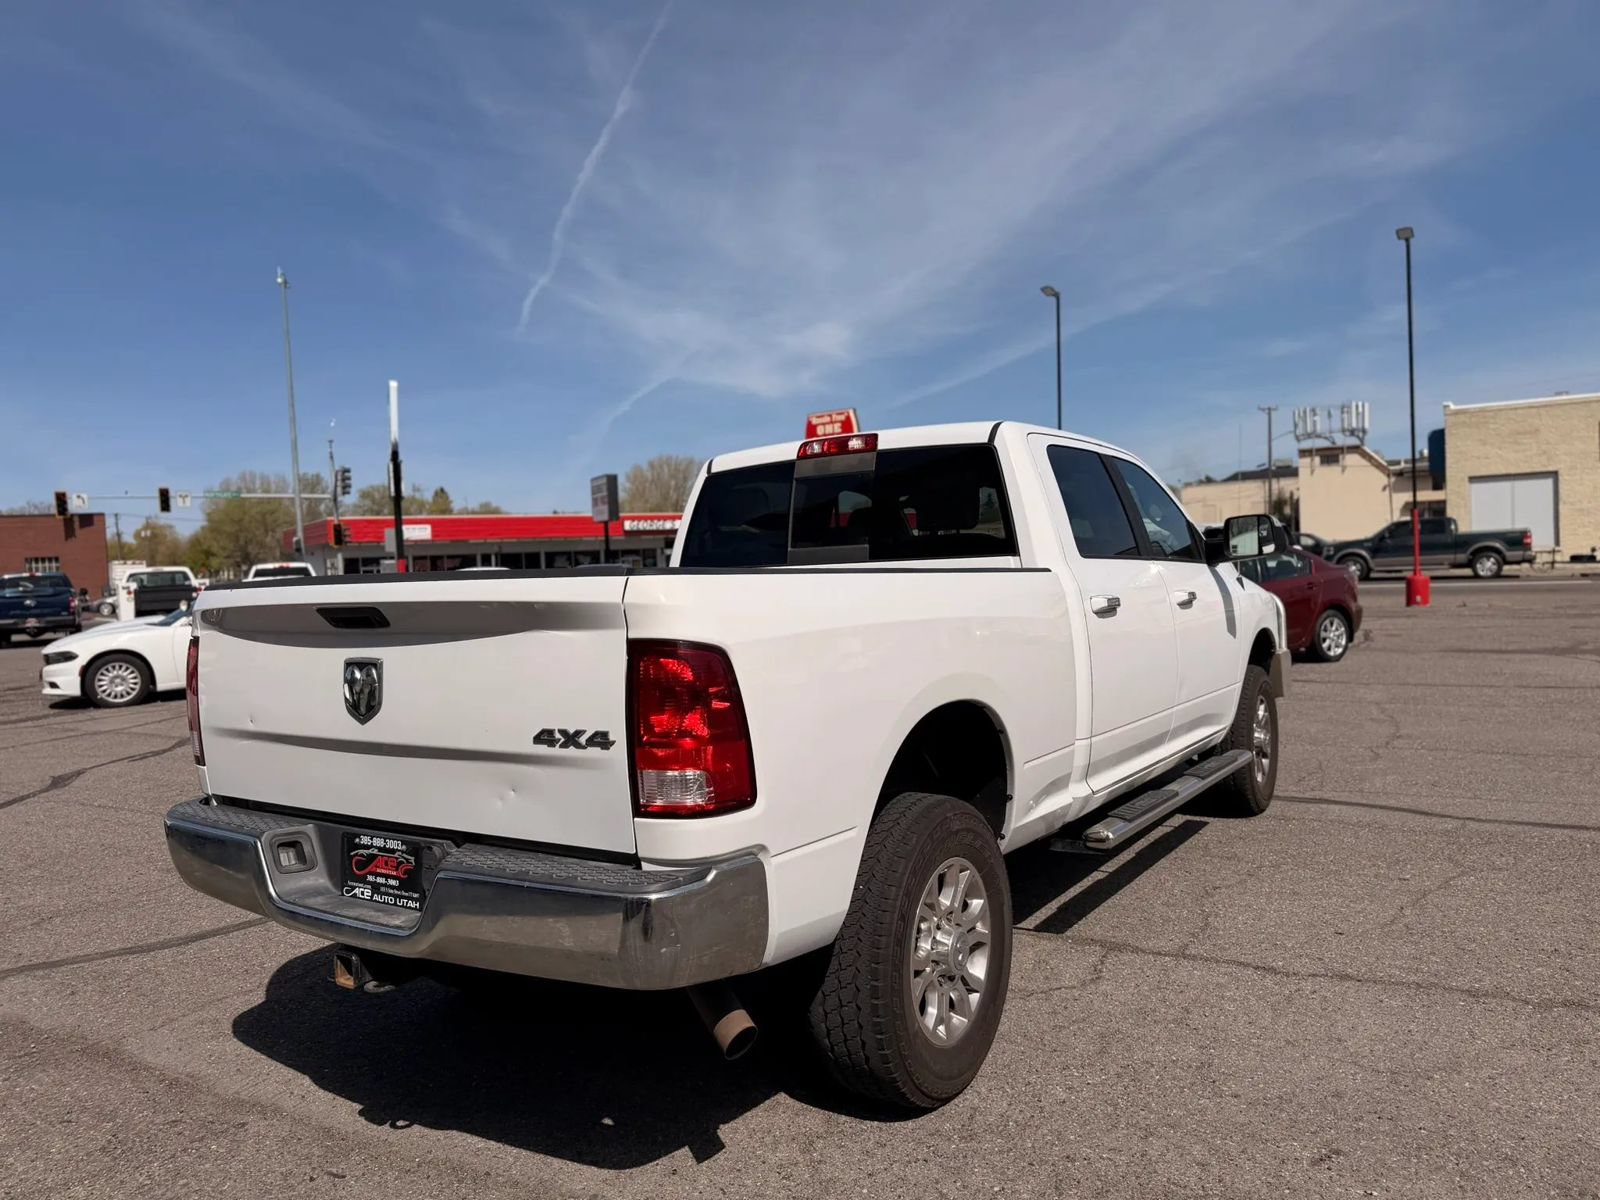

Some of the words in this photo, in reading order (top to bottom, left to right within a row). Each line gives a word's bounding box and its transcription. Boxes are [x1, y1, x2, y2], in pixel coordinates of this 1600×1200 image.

[628, 519, 676, 531] GEORGES
[532, 728, 616, 750] 4X4
[373, 893, 395, 904] AUTO
[396, 897, 420, 909] UTAH
